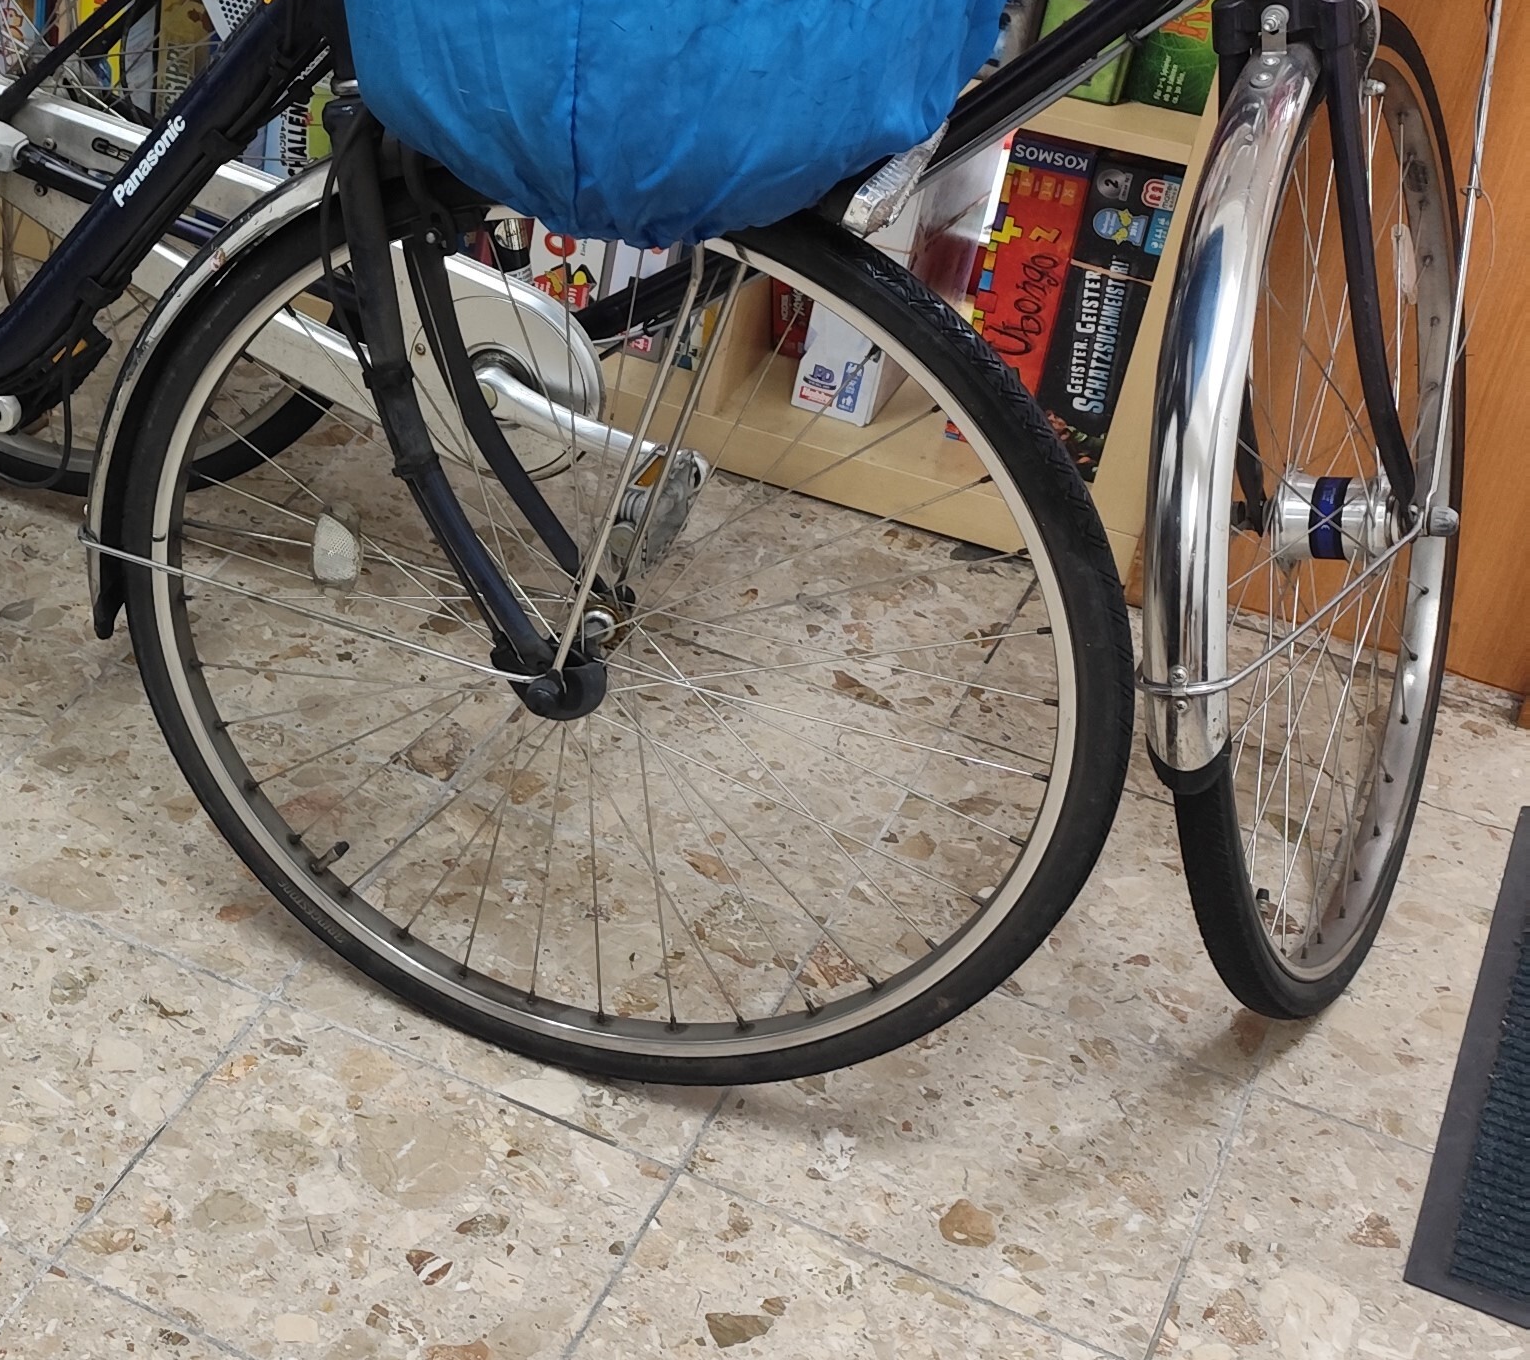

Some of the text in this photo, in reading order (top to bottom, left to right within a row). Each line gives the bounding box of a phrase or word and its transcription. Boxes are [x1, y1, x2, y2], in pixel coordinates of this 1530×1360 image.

[112, 114, 187, 208] Panasonic
[1014, 143, 1089, 172] KOSMOS
[1104, 178, 1119, 189] 2
[990, 252, 1059, 356] Ubongo
[1072, 259, 1131, 415] SCHATZSUCHMEISTR!
